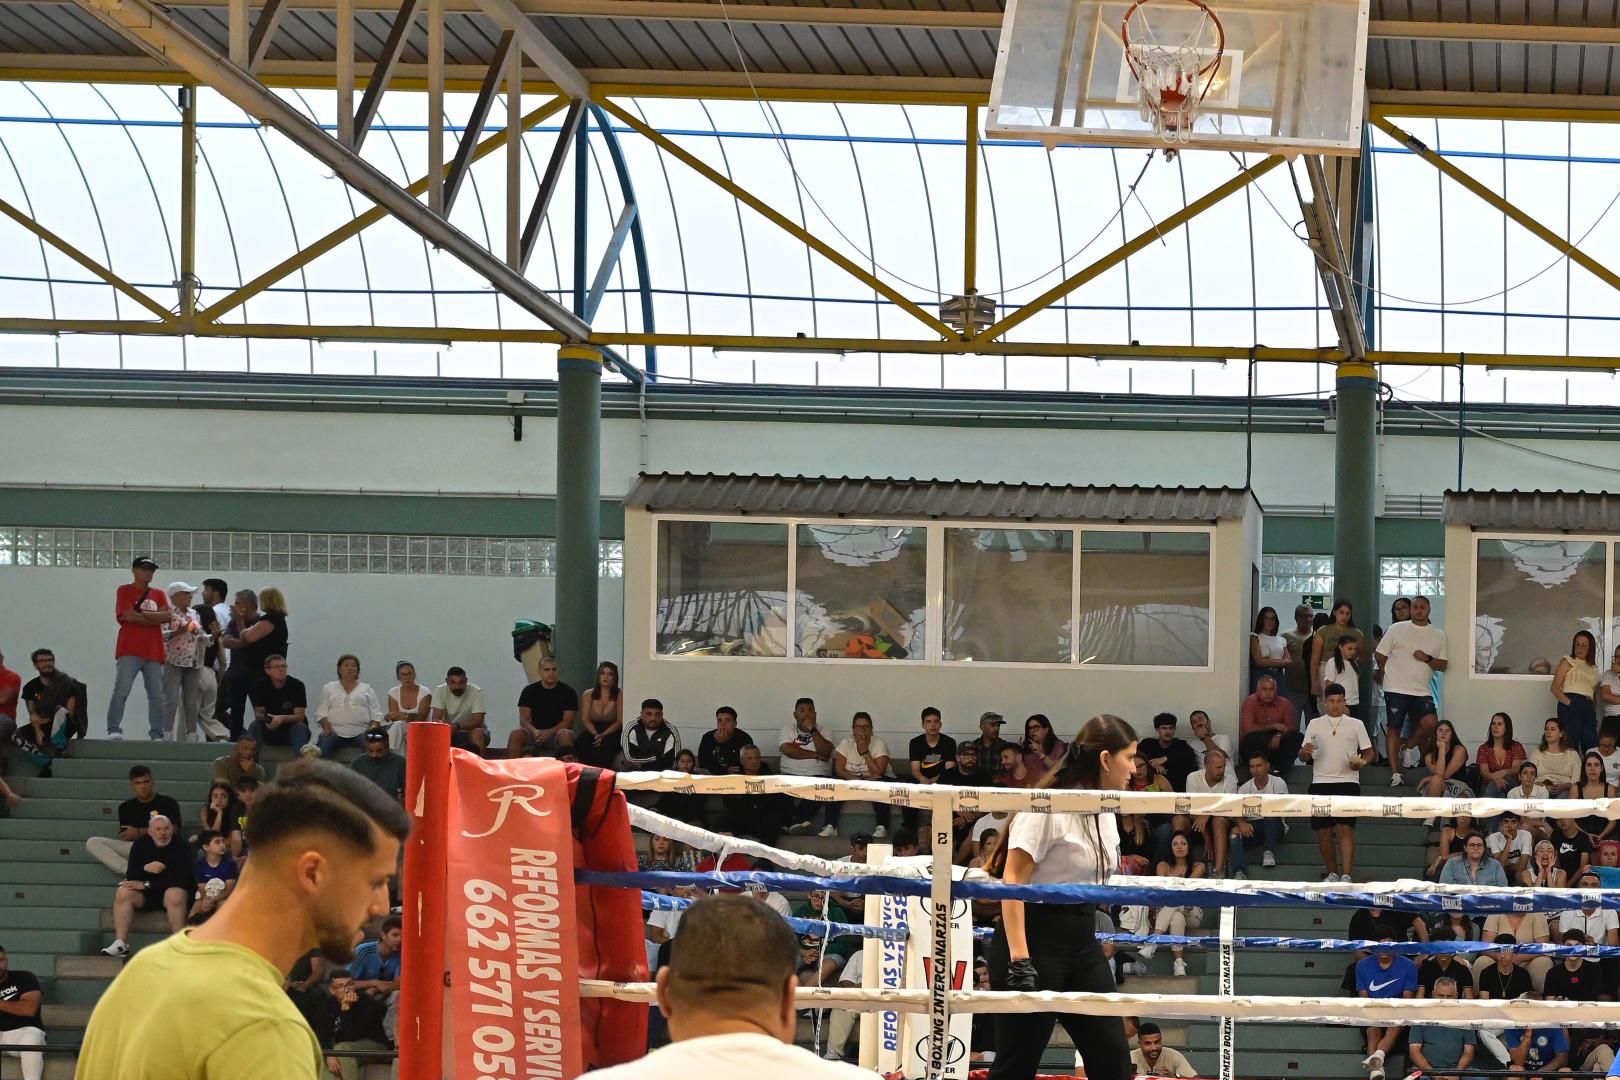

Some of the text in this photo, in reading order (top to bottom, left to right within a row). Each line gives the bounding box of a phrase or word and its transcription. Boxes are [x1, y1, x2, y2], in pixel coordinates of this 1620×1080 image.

[463, 878, 511, 949] 662
[510, 848, 562, 982] REFORMAS
[468, 957, 513, 1018] 571
[933, 903, 947, 1015] INTERCANARIAS
[1223, 944, 1231, 996] RCANARIAS
[523, 988, 560, 1006] Y
[931, 1015, 945, 1069] BOXING
